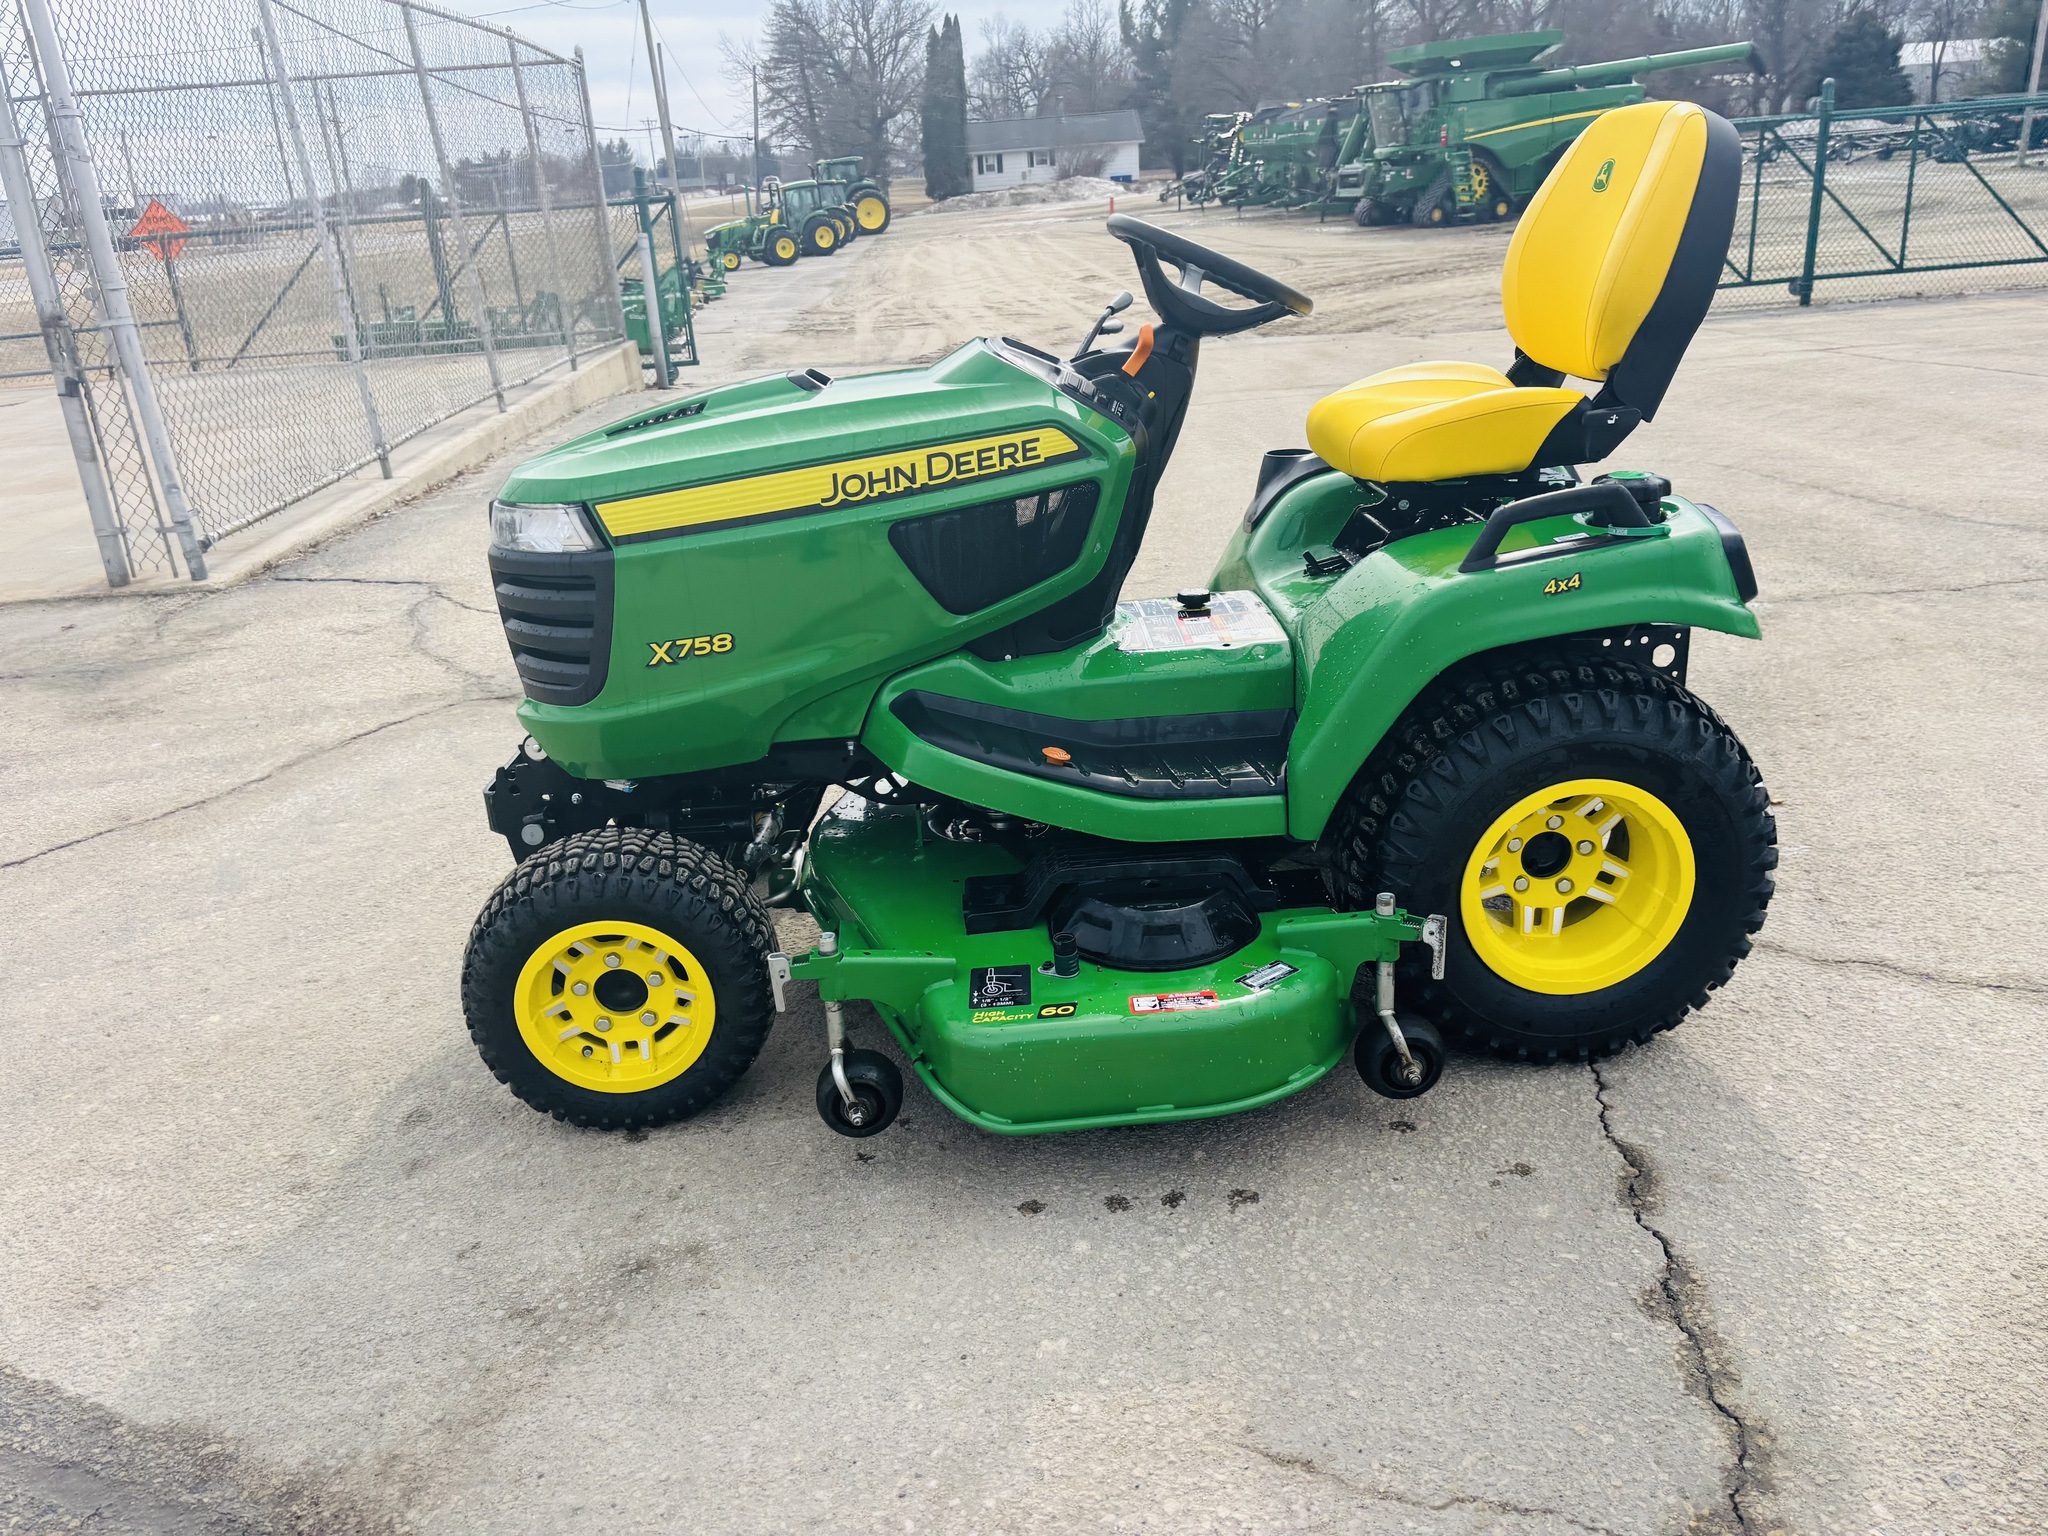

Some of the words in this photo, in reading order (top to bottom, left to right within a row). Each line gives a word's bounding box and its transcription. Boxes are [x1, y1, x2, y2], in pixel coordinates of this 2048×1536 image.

[820, 462, 918, 504] JOHN
[926, 436, 1043, 483] DEERE
[1543, 572, 1582, 594] 4x4
[647, 632, 733, 666] X758
[972, 1013, 1034, 1023] CAPACITY
[1040, 1006, 1075, 1016] 60
